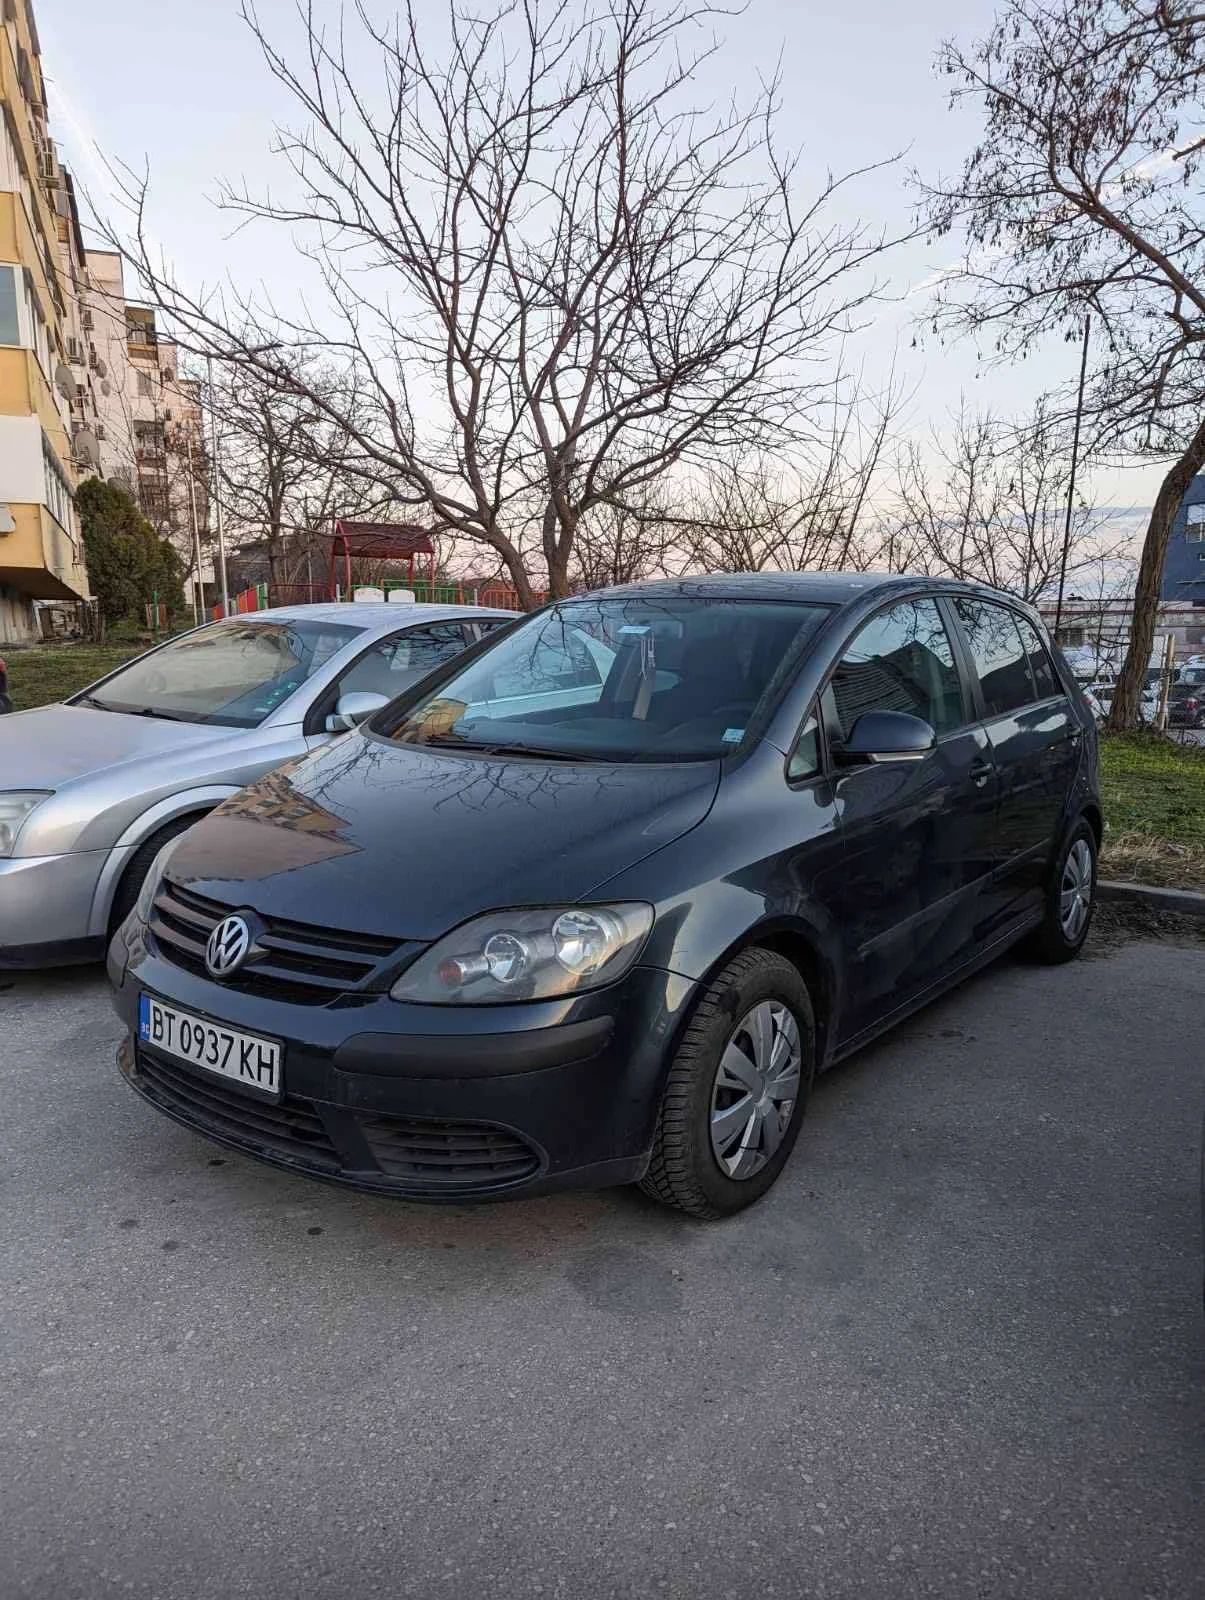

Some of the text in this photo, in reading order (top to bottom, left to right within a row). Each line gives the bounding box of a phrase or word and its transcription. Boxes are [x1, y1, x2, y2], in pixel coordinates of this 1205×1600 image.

[208, 915, 250, 972] VW
[152, 1006, 275, 1086] BT 0937 KH
